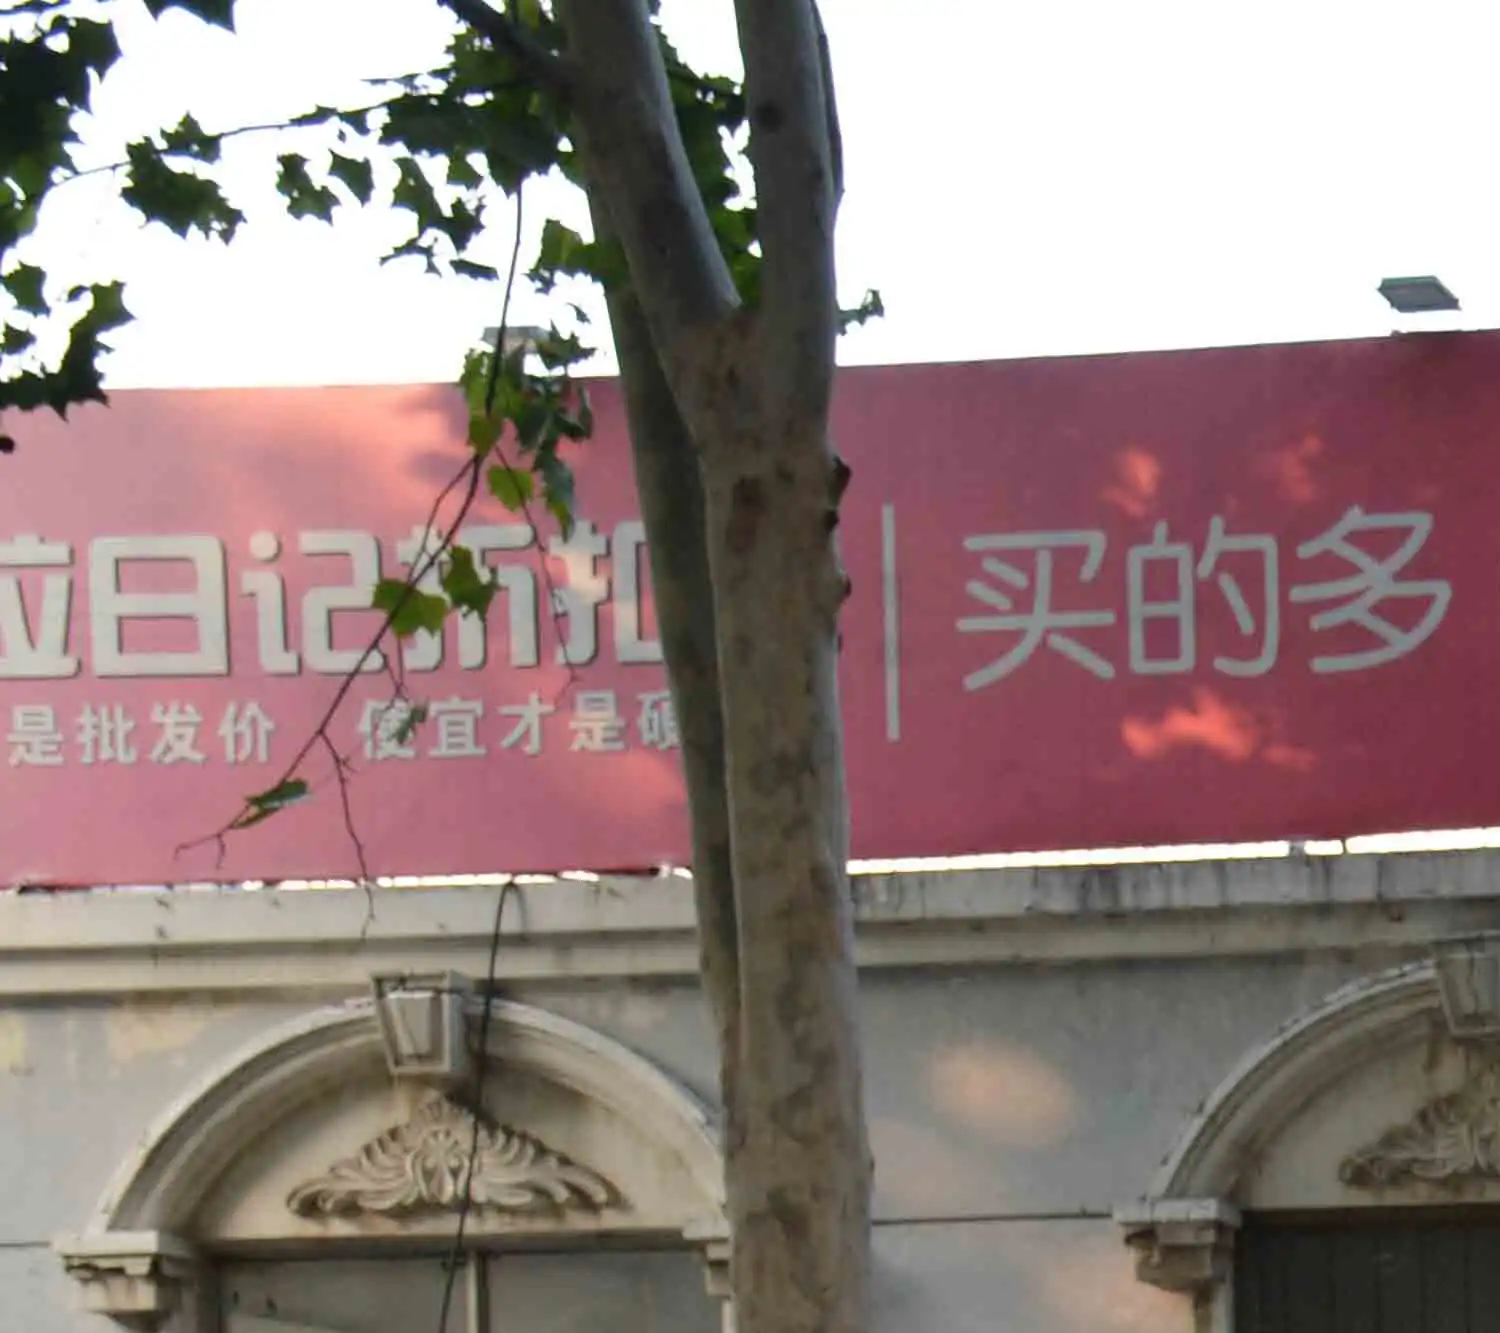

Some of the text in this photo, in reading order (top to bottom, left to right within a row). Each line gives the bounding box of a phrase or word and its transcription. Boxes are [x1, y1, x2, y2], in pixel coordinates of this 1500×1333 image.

[955, 504, 1452, 691] 买的多
[6, 698, 276, 768] 是批发价
